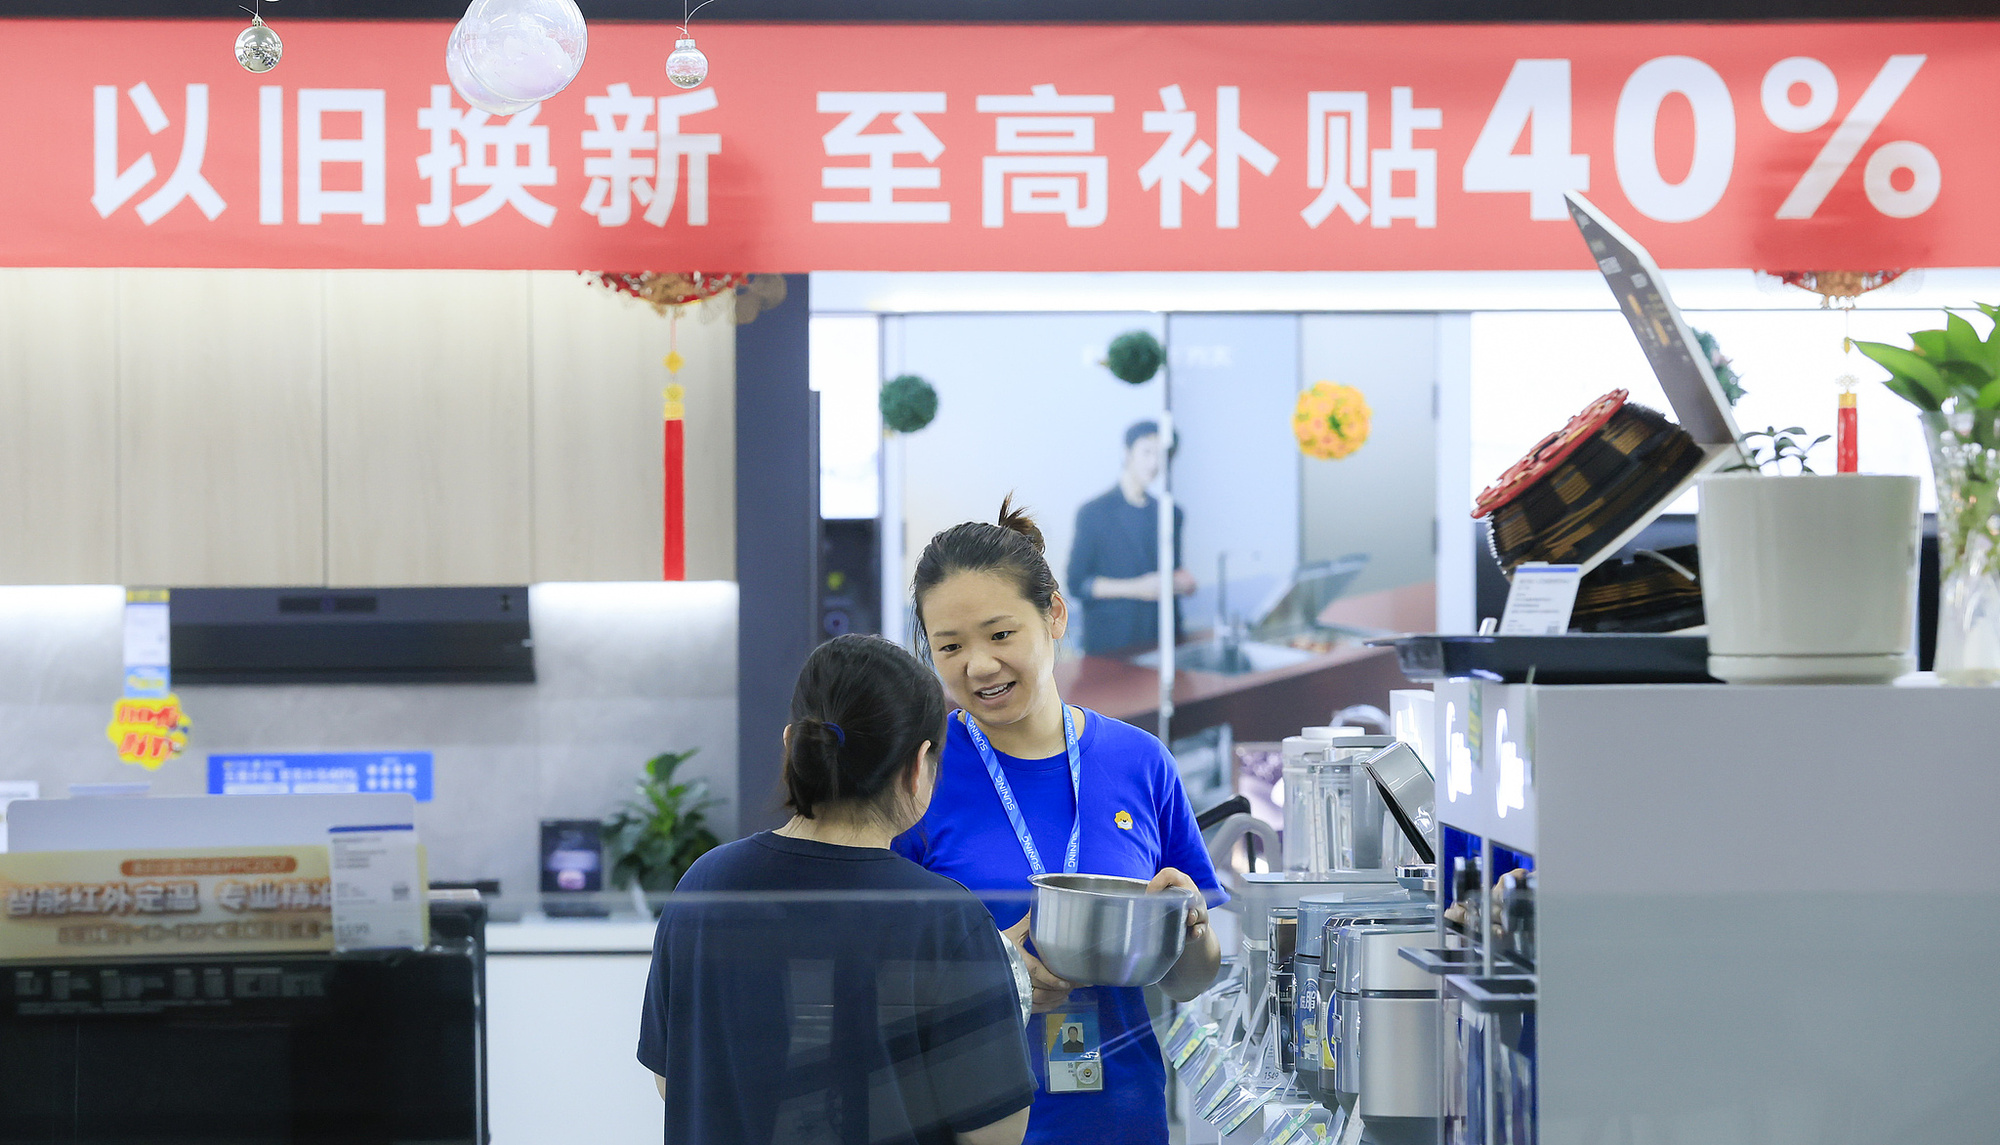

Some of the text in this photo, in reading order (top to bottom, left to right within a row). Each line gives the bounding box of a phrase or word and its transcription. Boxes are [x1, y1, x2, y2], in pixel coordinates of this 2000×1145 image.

[90, 80, 722, 228] 以旧换新
[968, 719, 989, 752] SUNING
[1064, 713, 1076, 745] SUNING
[994, 775, 1016, 811] SUNING
[1021, 835, 1041, 871] SUNING
[1067, 832, 1078, 868] SUNING
[7, 882, 199, 915] 智能红外定温
[1264, 1071, 1279, 1081] 1549
